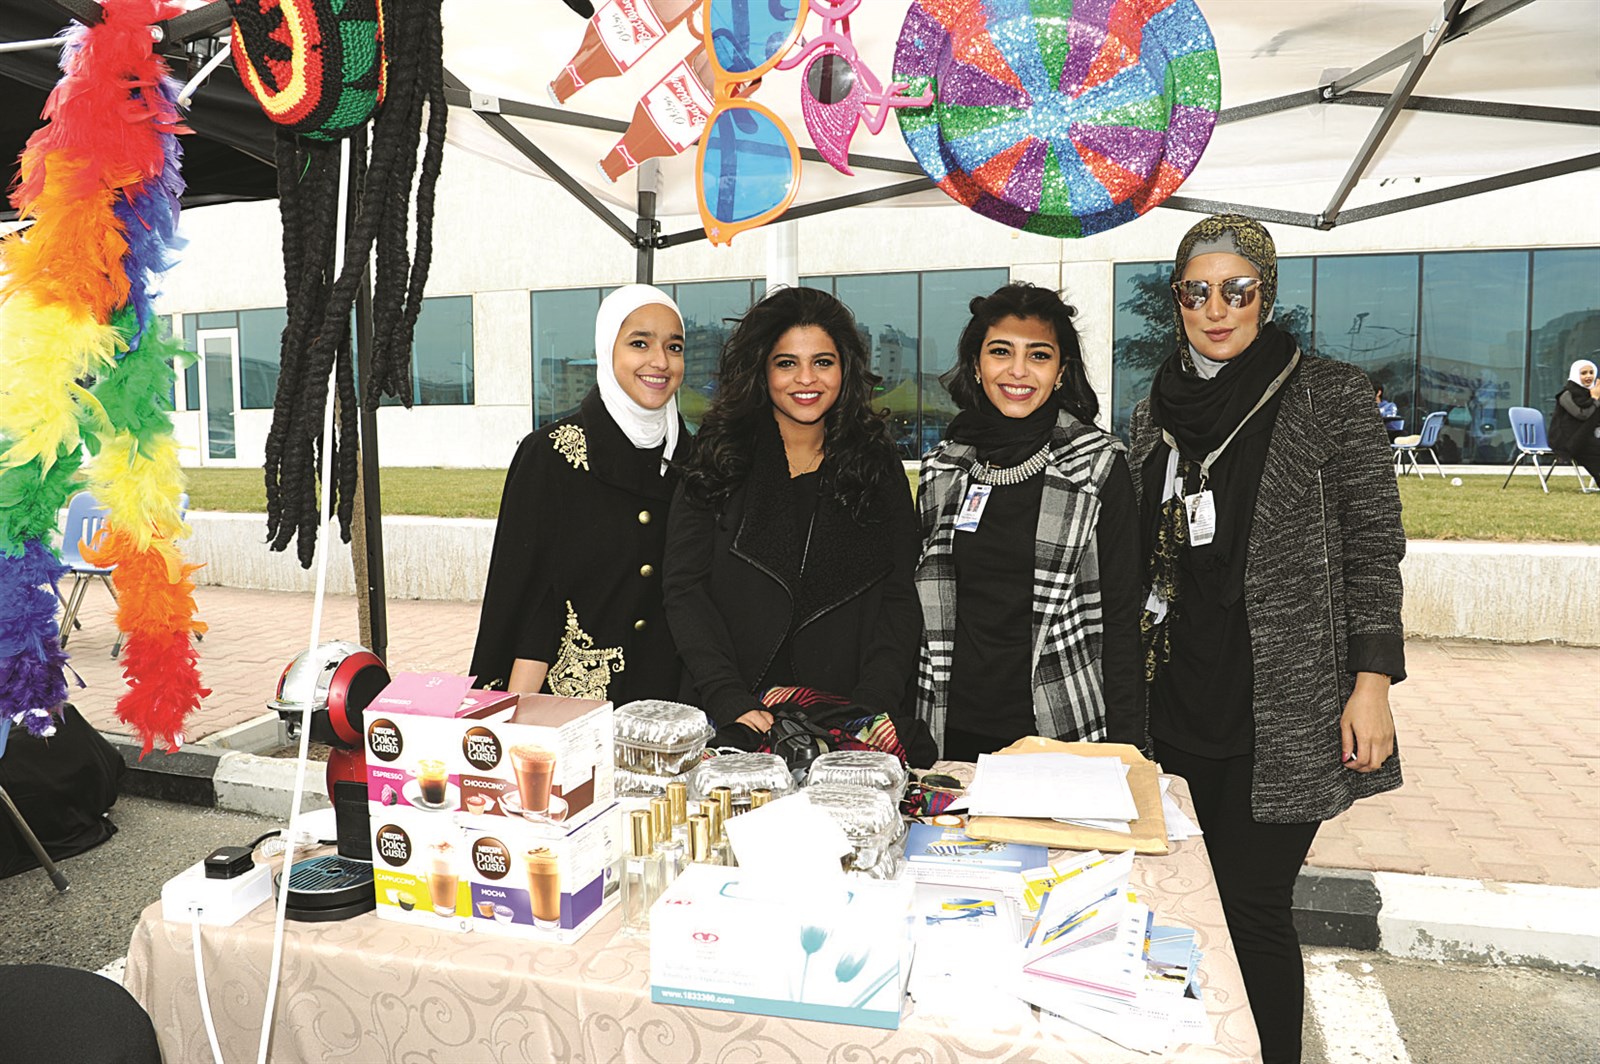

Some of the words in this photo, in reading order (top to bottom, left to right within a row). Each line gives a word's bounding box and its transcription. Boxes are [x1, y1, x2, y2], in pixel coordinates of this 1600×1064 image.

[371, 732, 399, 746] Dolce
[372, 742, 400, 754] Gusto
[467, 741, 497, 754] Dolce
[467, 750, 498, 763] Gusto
[372, 770, 404, 781] ESPRESSO
[380, 838, 407, 852] Dolce
[381, 846, 408, 859] Gusto
[475, 852, 506, 865] Dolce
[477, 860, 507, 873] Gusto
[377, 873, 416, 887] CAPPUCCINO
[481, 888, 507, 899] MOCHA
